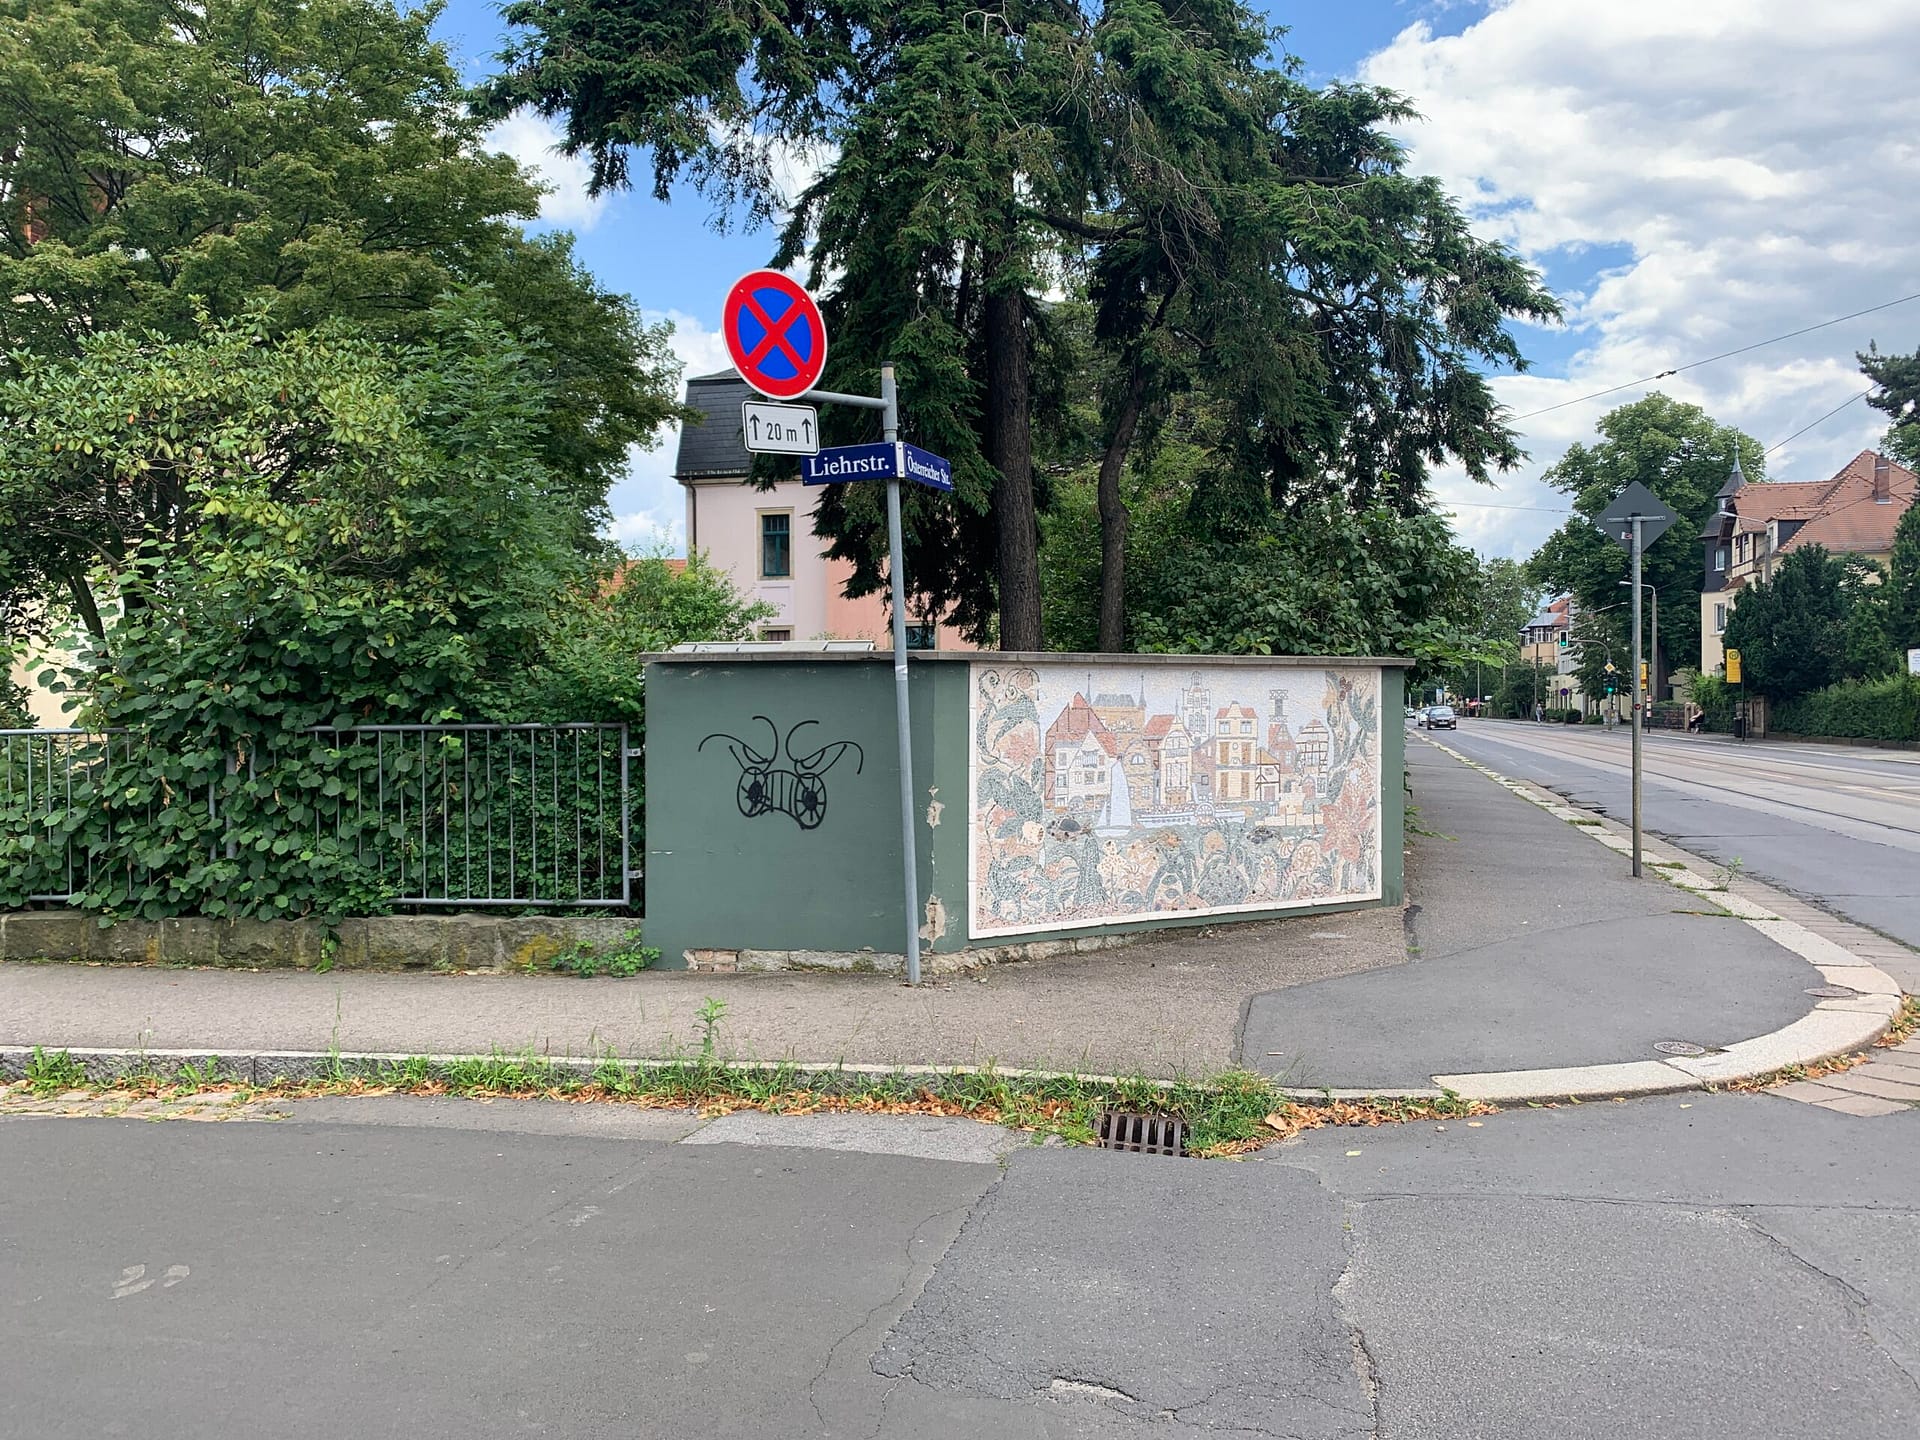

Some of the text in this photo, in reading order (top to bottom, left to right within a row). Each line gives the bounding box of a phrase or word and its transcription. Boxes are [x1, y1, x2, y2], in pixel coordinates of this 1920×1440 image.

[766, 422, 798, 442] 20 m
[809, 455, 890, 477] Liehrstr.
[907, 450, 951, 485] Österreicher Str.
